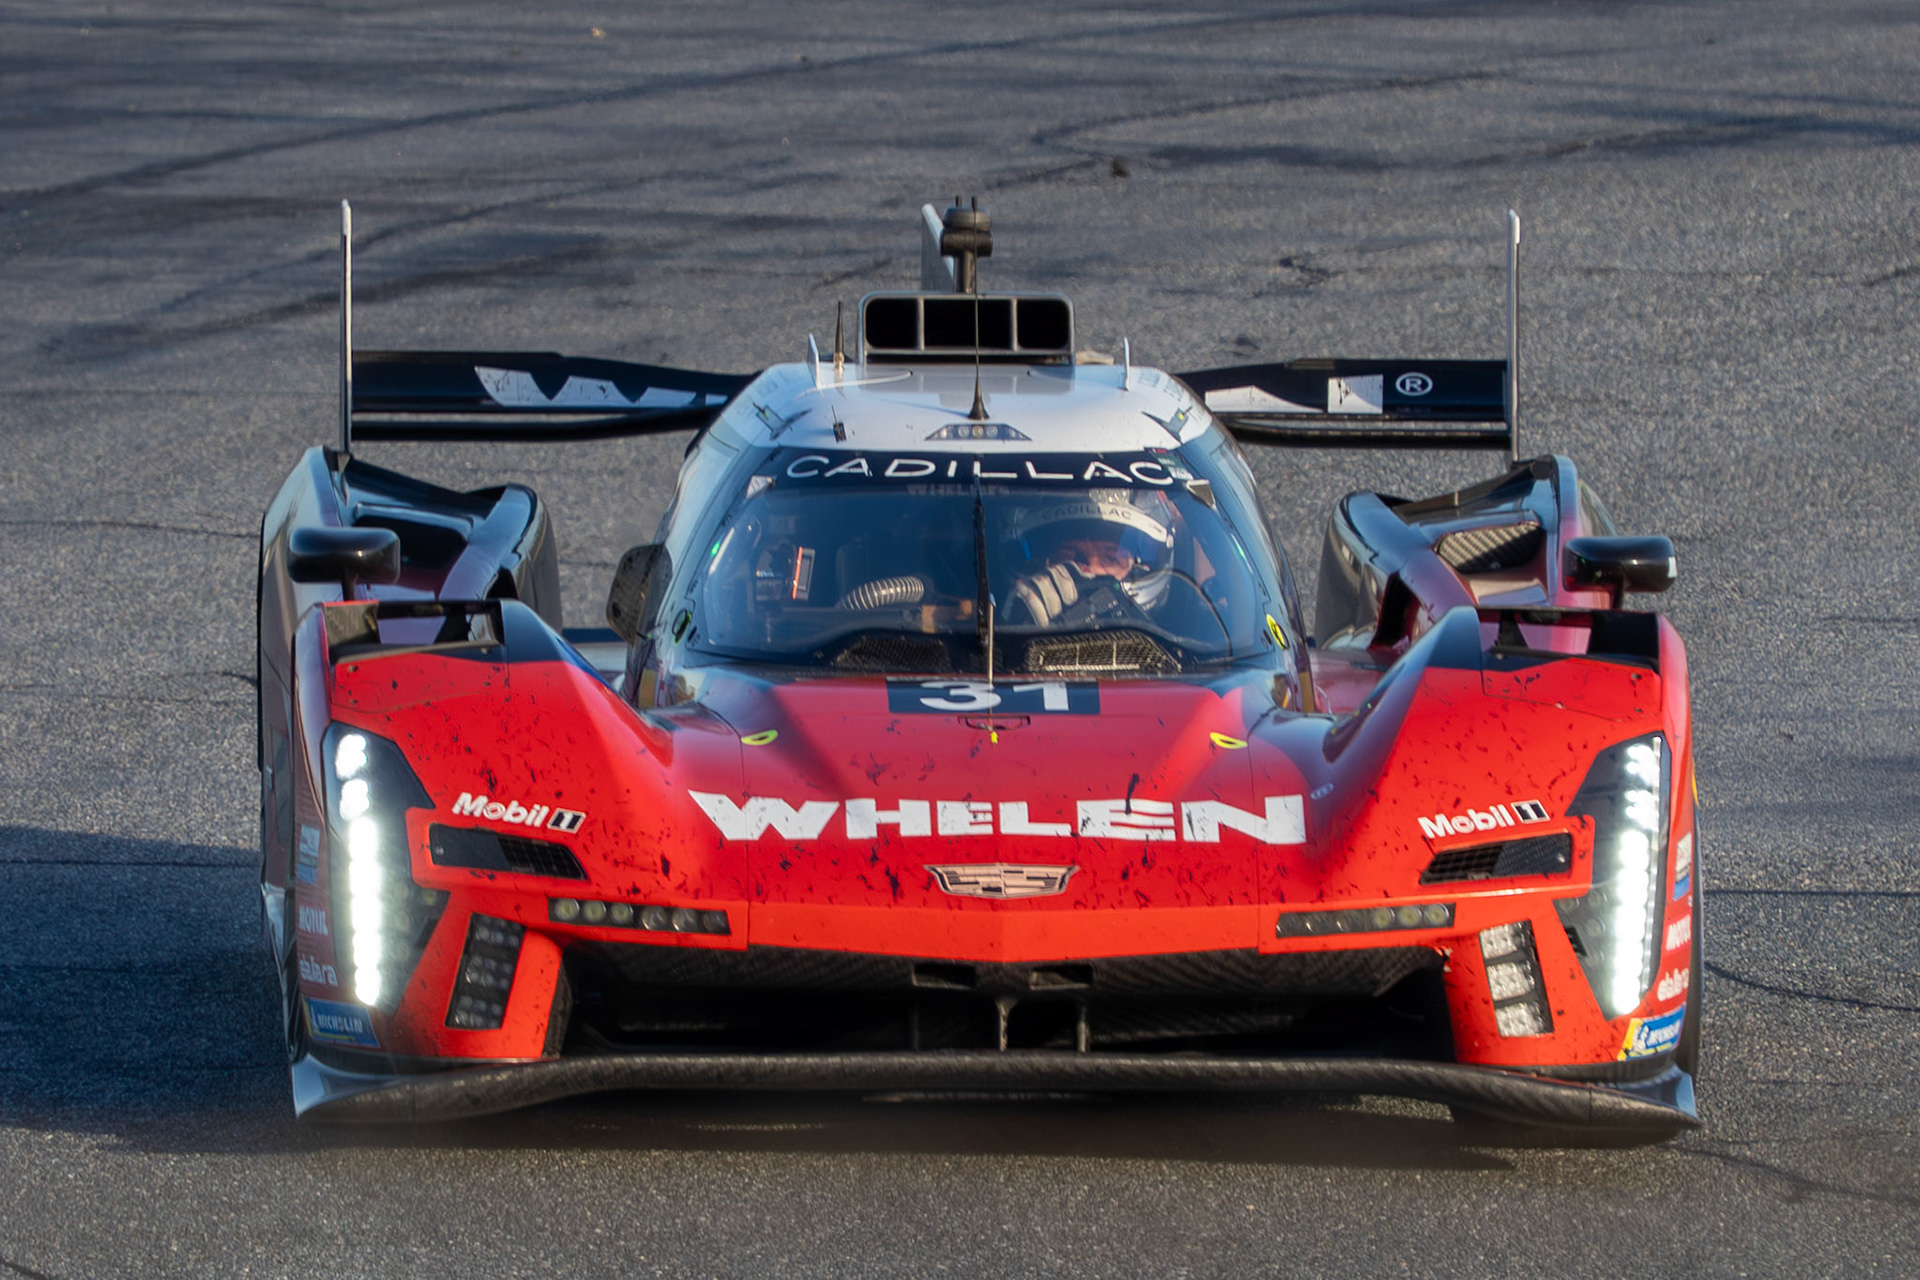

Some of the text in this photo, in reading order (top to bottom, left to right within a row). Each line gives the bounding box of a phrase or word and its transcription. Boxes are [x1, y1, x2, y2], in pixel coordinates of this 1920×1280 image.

[787, 455, 1174, 486] CADILLAC
[920, 681, 1069, 711] 31
[452, 792, 550, 828] Mobil
[688, 789, 1307, 845] WHELEN
[1418, 804, 1515, 839] Mobil
